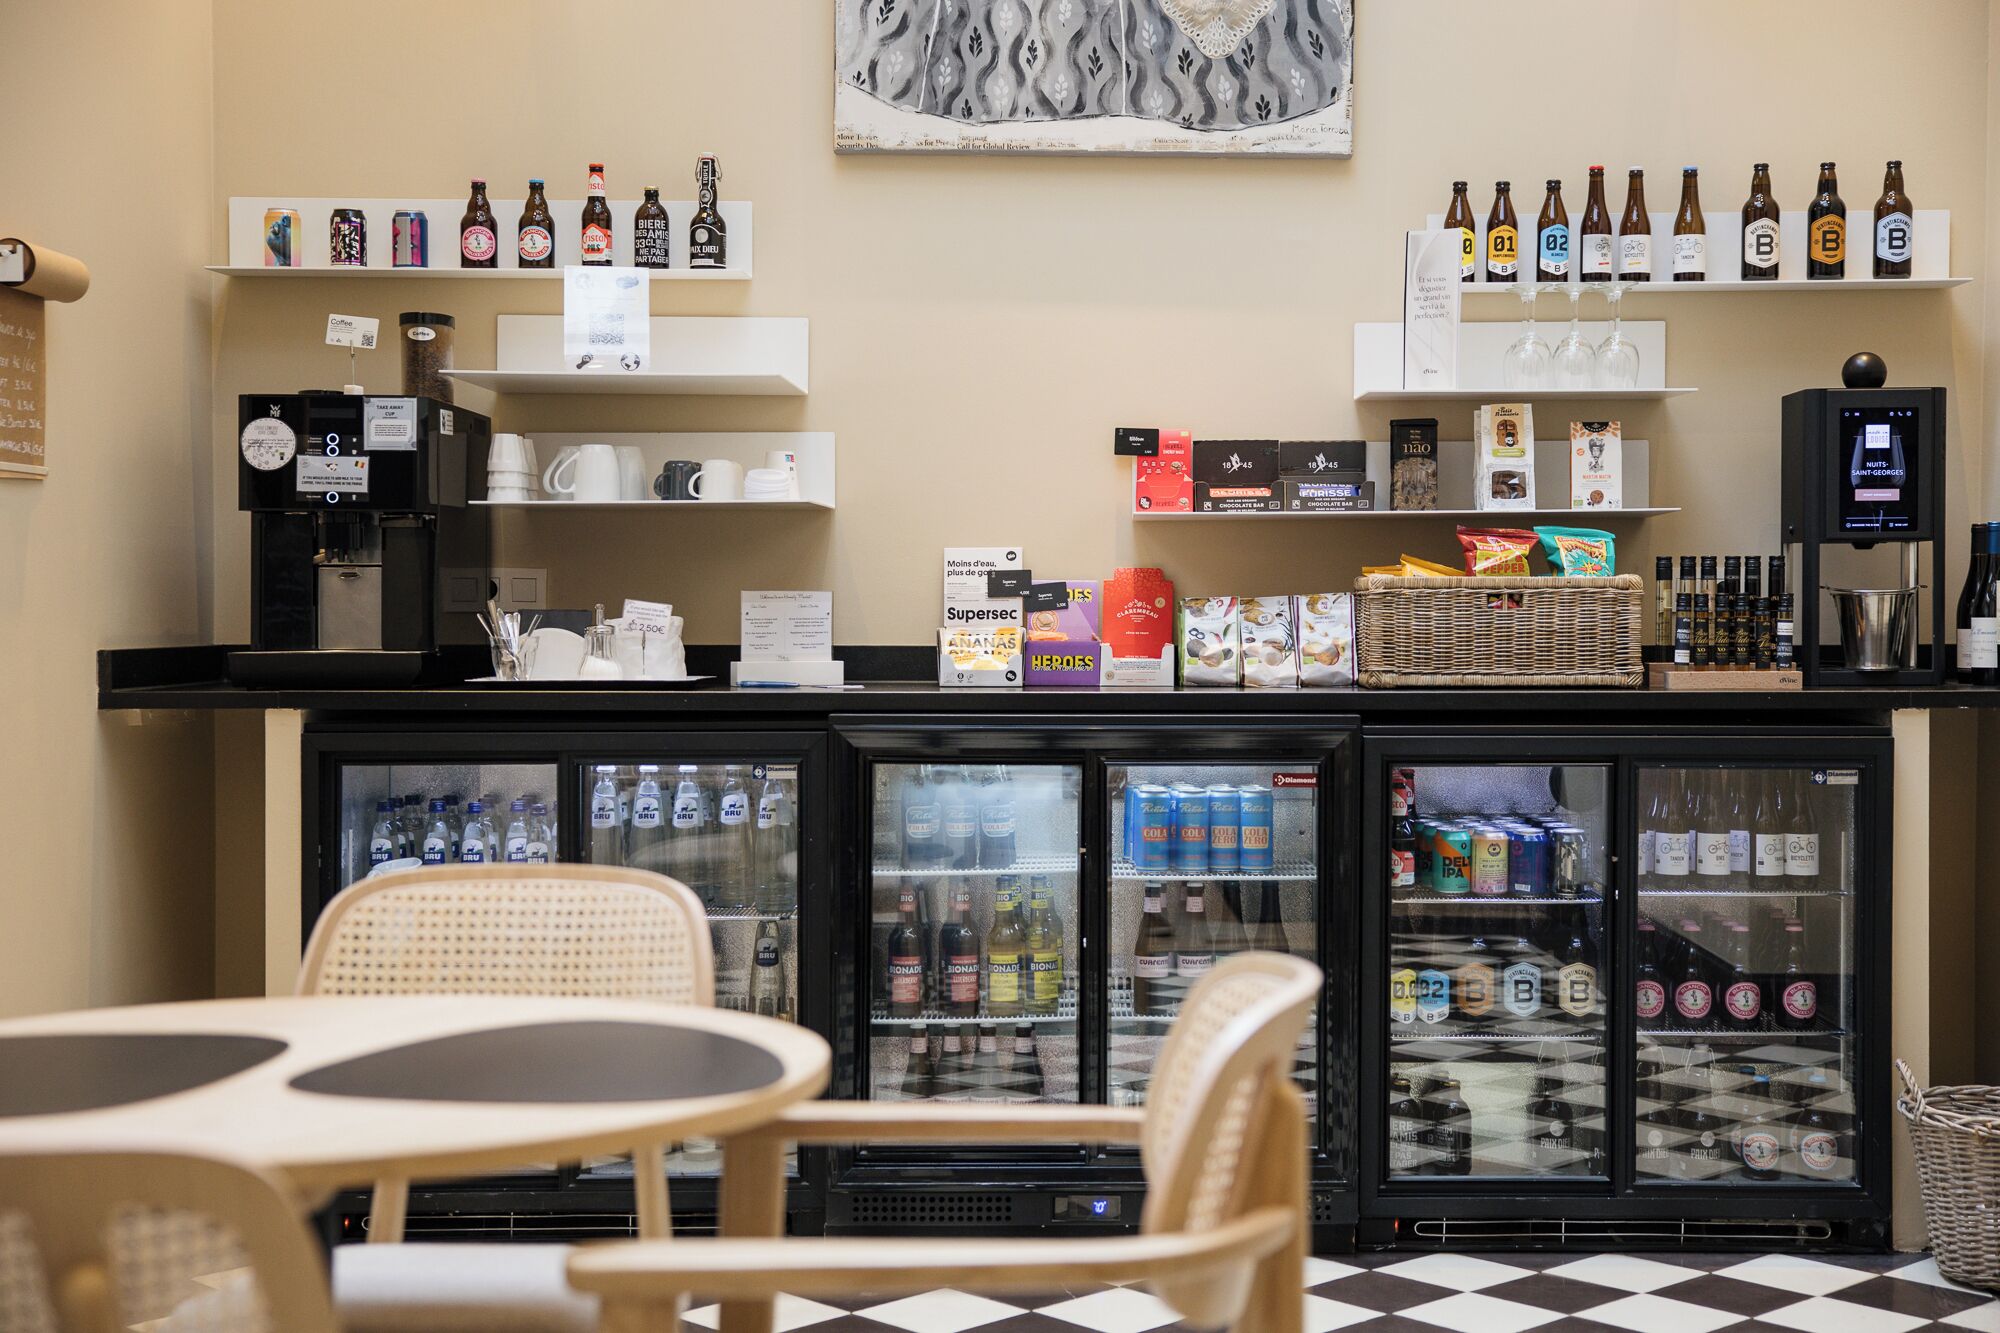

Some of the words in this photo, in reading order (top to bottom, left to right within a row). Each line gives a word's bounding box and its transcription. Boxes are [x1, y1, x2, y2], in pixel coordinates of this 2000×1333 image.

[648, 230, 669, 240] AMIS
[1889, 228, 1907, 250] B
[1546, 234, 1568, 252] 02
[1756, 234, 1774, 255] B
[1822, 230, 1840, 251] B
[330, 319, 353, 327] Coffee
[973, 560, 997, 568] d'eau,
[1484, 563, 1524, 574] PEPPER
[947, 569, 963, 577] plus
[947, 607, 1017, 622] Supersec
[639, 624, 666, 634] 250€
[949, 638, 1016, 649] ANANAS
[1144, 829, 1167, 837] COLA
[1182, 829, 1205, 837] COLA
[1213, 827, 1236, 836] COLA
[1244, 828, 1268, 836] COLA
[1244, 836, 1267, 845] ZERO
[1443, 868, 1463, 878] IPA
[1466, 981, 1485, 1002] B
[1514, 980, 1534, 1002] B
[1570, 980, 1590, 1002] B
